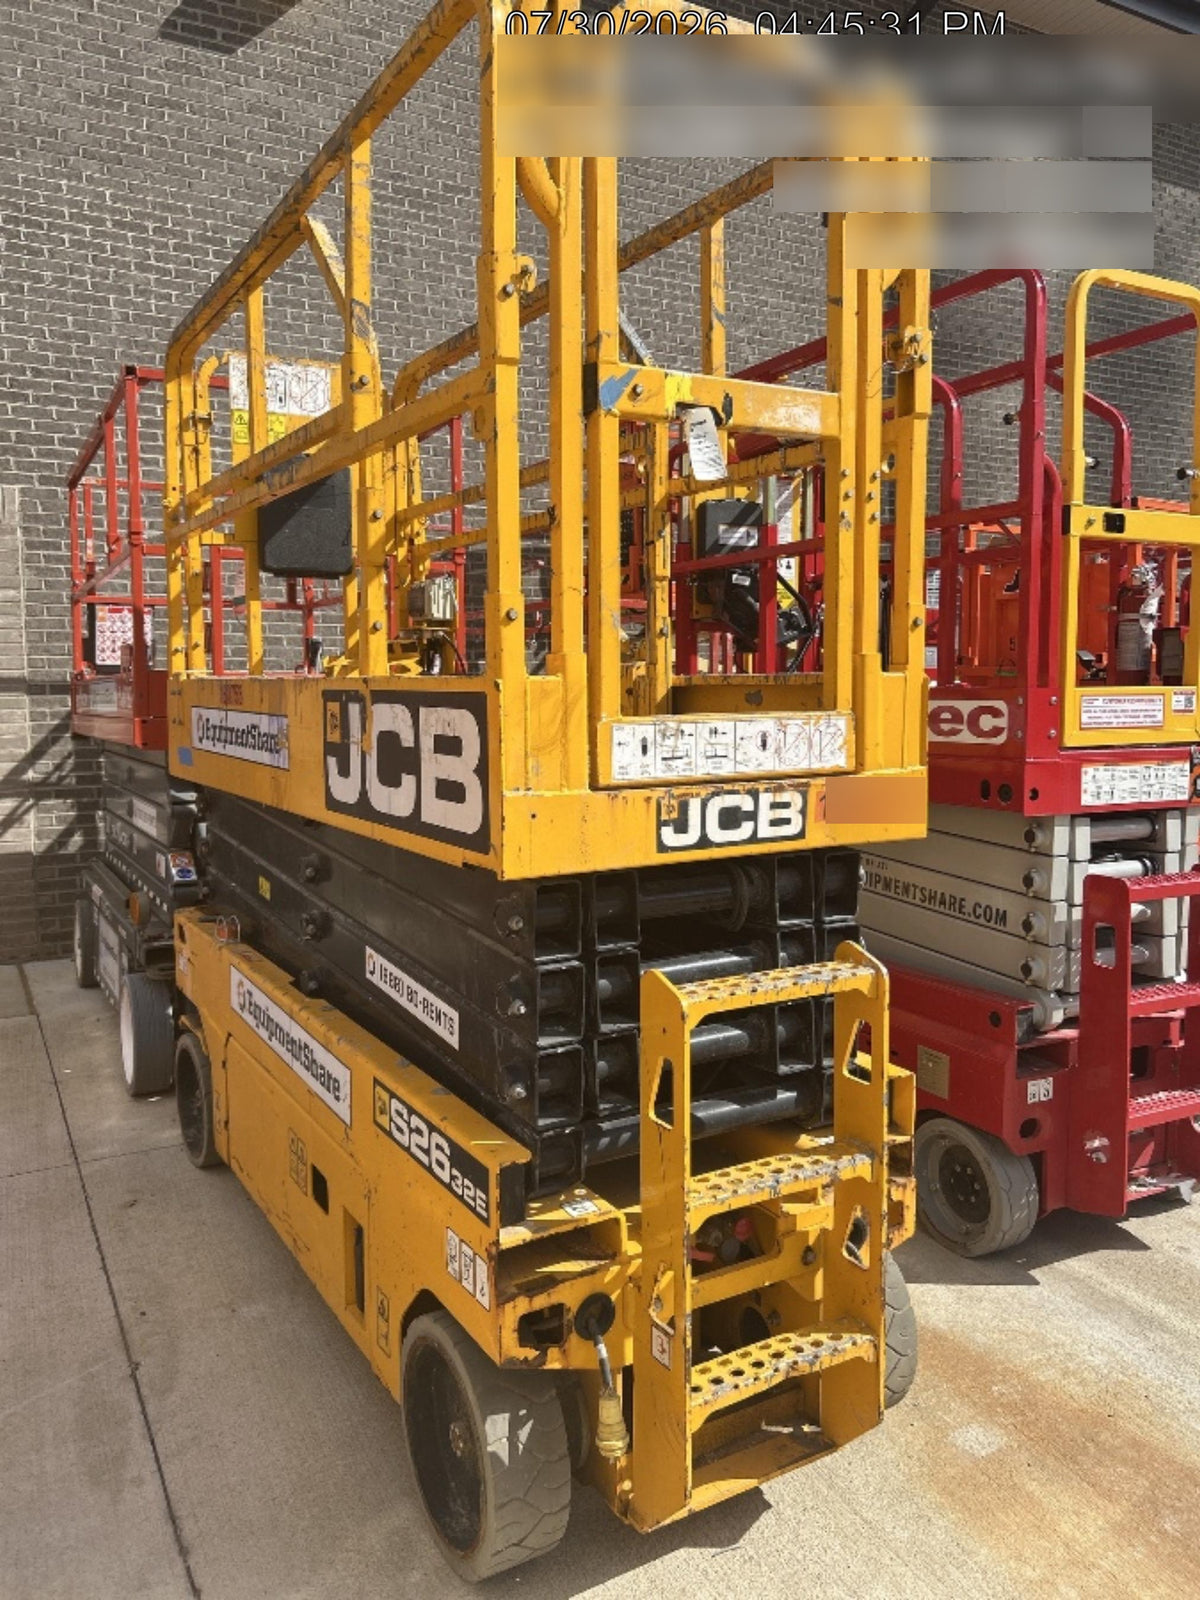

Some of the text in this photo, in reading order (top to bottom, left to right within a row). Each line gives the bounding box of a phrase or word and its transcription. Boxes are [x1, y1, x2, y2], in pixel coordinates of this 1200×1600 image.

[326, 702, 483, 835] JCB
[661, 791, 803, 847] JCB
[247, 989, 341, 1103] EquipmentShare
